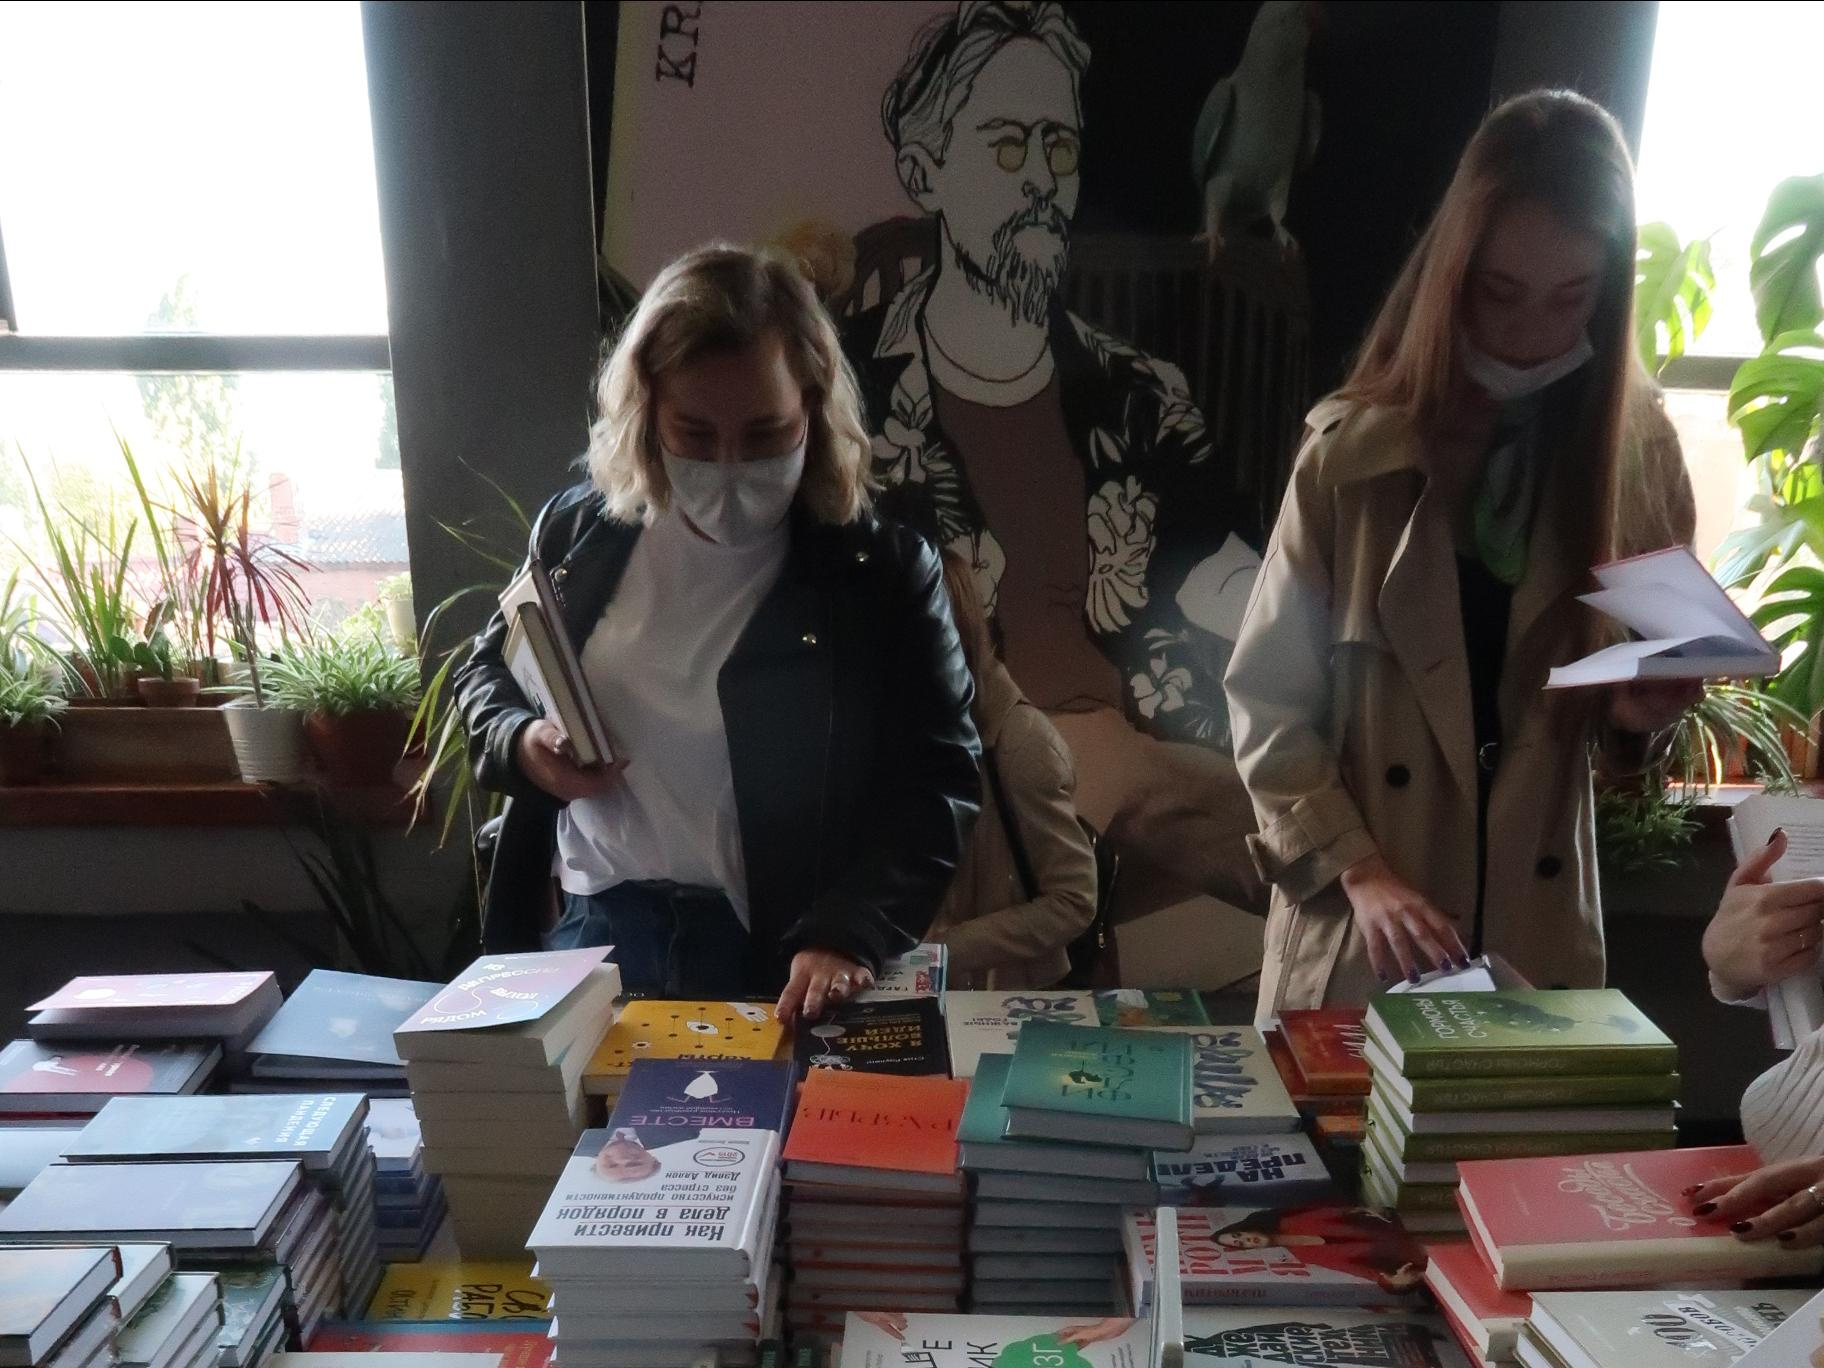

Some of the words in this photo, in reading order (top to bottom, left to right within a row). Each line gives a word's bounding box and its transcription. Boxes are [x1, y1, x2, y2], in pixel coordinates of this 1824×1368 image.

[655, 0, 703, 87] KR
[629, 1114, 755, 1127] ВМЕСТЕ
[1236, 1167, 1284, 1183] НА
[556, 1205, 643, 1222] порядок
[654, 1205, 667, 1219] в
[679, 1206, 731, 1222] дела
[573, 1223, 671, 1239] привести
[684, 1224, 724, 1241] Как
